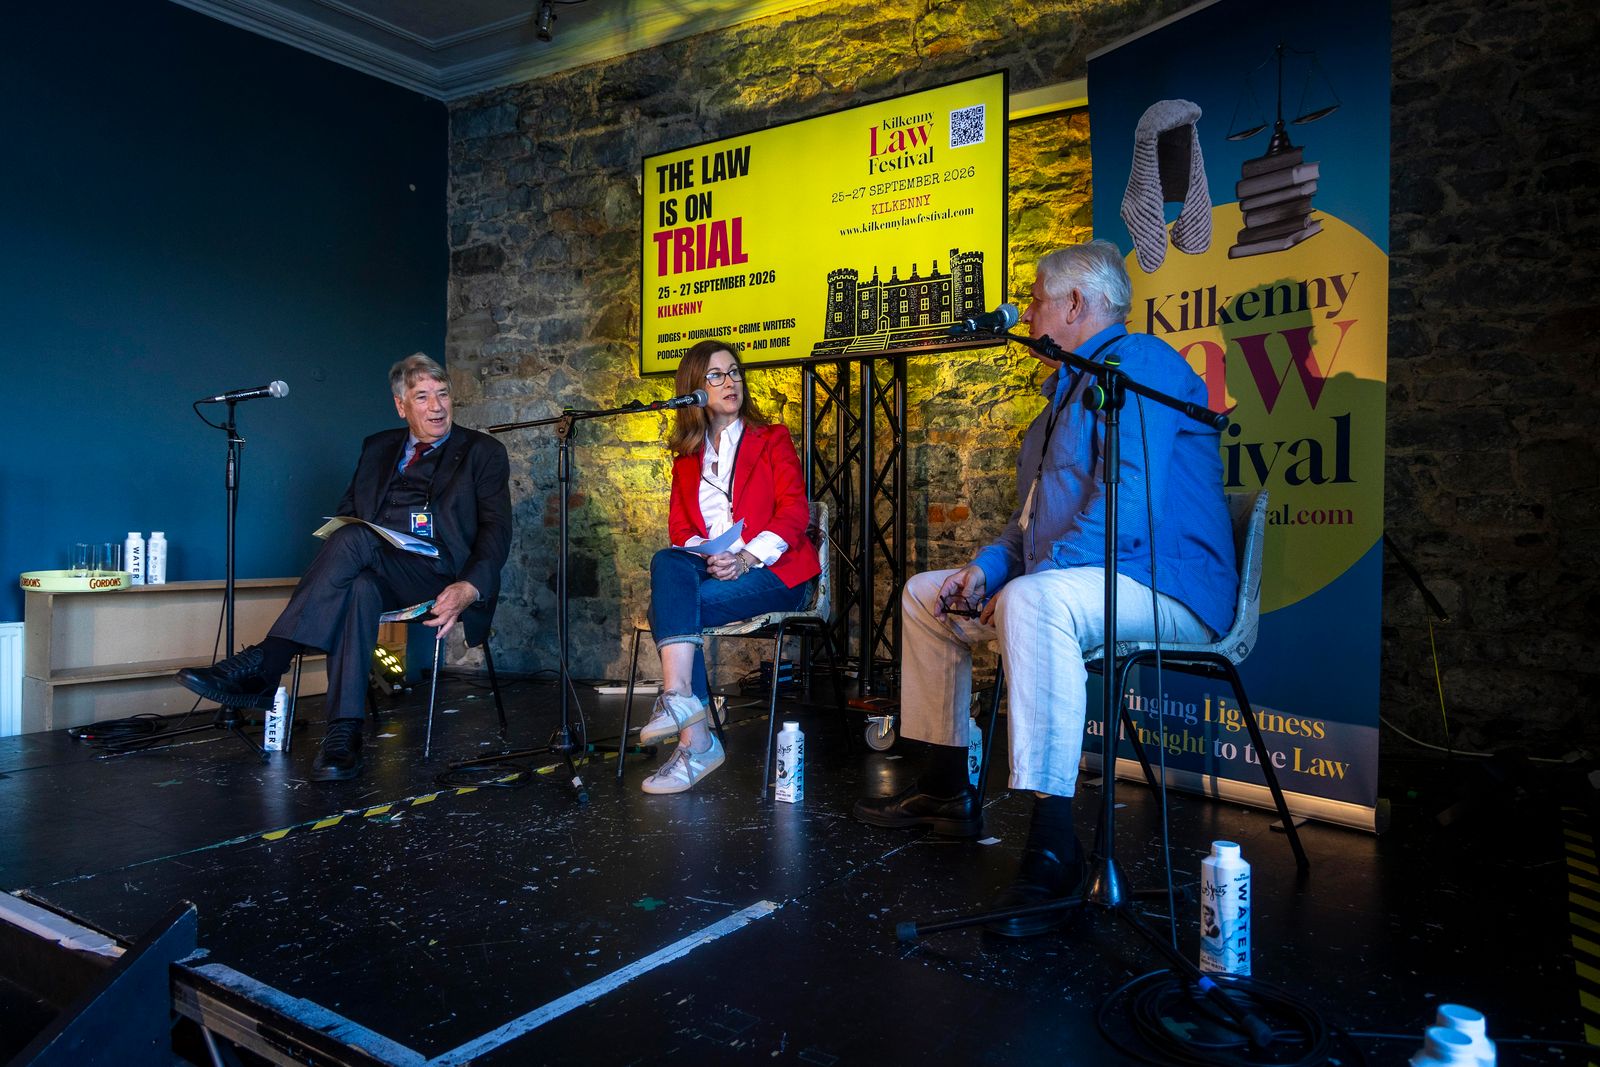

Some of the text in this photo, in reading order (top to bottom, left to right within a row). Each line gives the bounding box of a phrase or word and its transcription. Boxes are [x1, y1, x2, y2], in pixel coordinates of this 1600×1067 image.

[882, 112, 935, 131] Kilkenny
[869, 123, 935, 157] Law
[656, 145, 751, 194] THE LAW
[869, 146, 934, 175] Festival
[869, 173, 940, 197] SEPTEMBER
[943, 166, 975, 182] 2026
[659, 191, 713, 227] IS ON
[840, 206, 974, 236] www.kilkennylawfestival.com
[871, 194, 931, 215] KILKENNY
[653, 216, 749, 277] TRIAL
[658, 287, 670, 299] 25
[680, 283, 691, 296] 27
[693, 274, 746, 294] SEPTEMBER
[749, 270, 776, 286] 2026
[657, 300, 703, 319] KILKENNY
[1144, 272, 1360, 335] Kilkenny
[657, 318, 796, 343] JUDGES JOURNALISTS CRIME WRITERS
[752, 340, 768, 350] AND
[770, 337, 790, 348] MORE
[1179, 319, 1358, 415] aw
[1224, 411, 1358, 488] ival
[132, 546, 140, 579] WATER
[1213, 738, 1237, 760] to
[1293, 746, 1350, 780] Law
[1237, 883, 1248, 964] WATER
